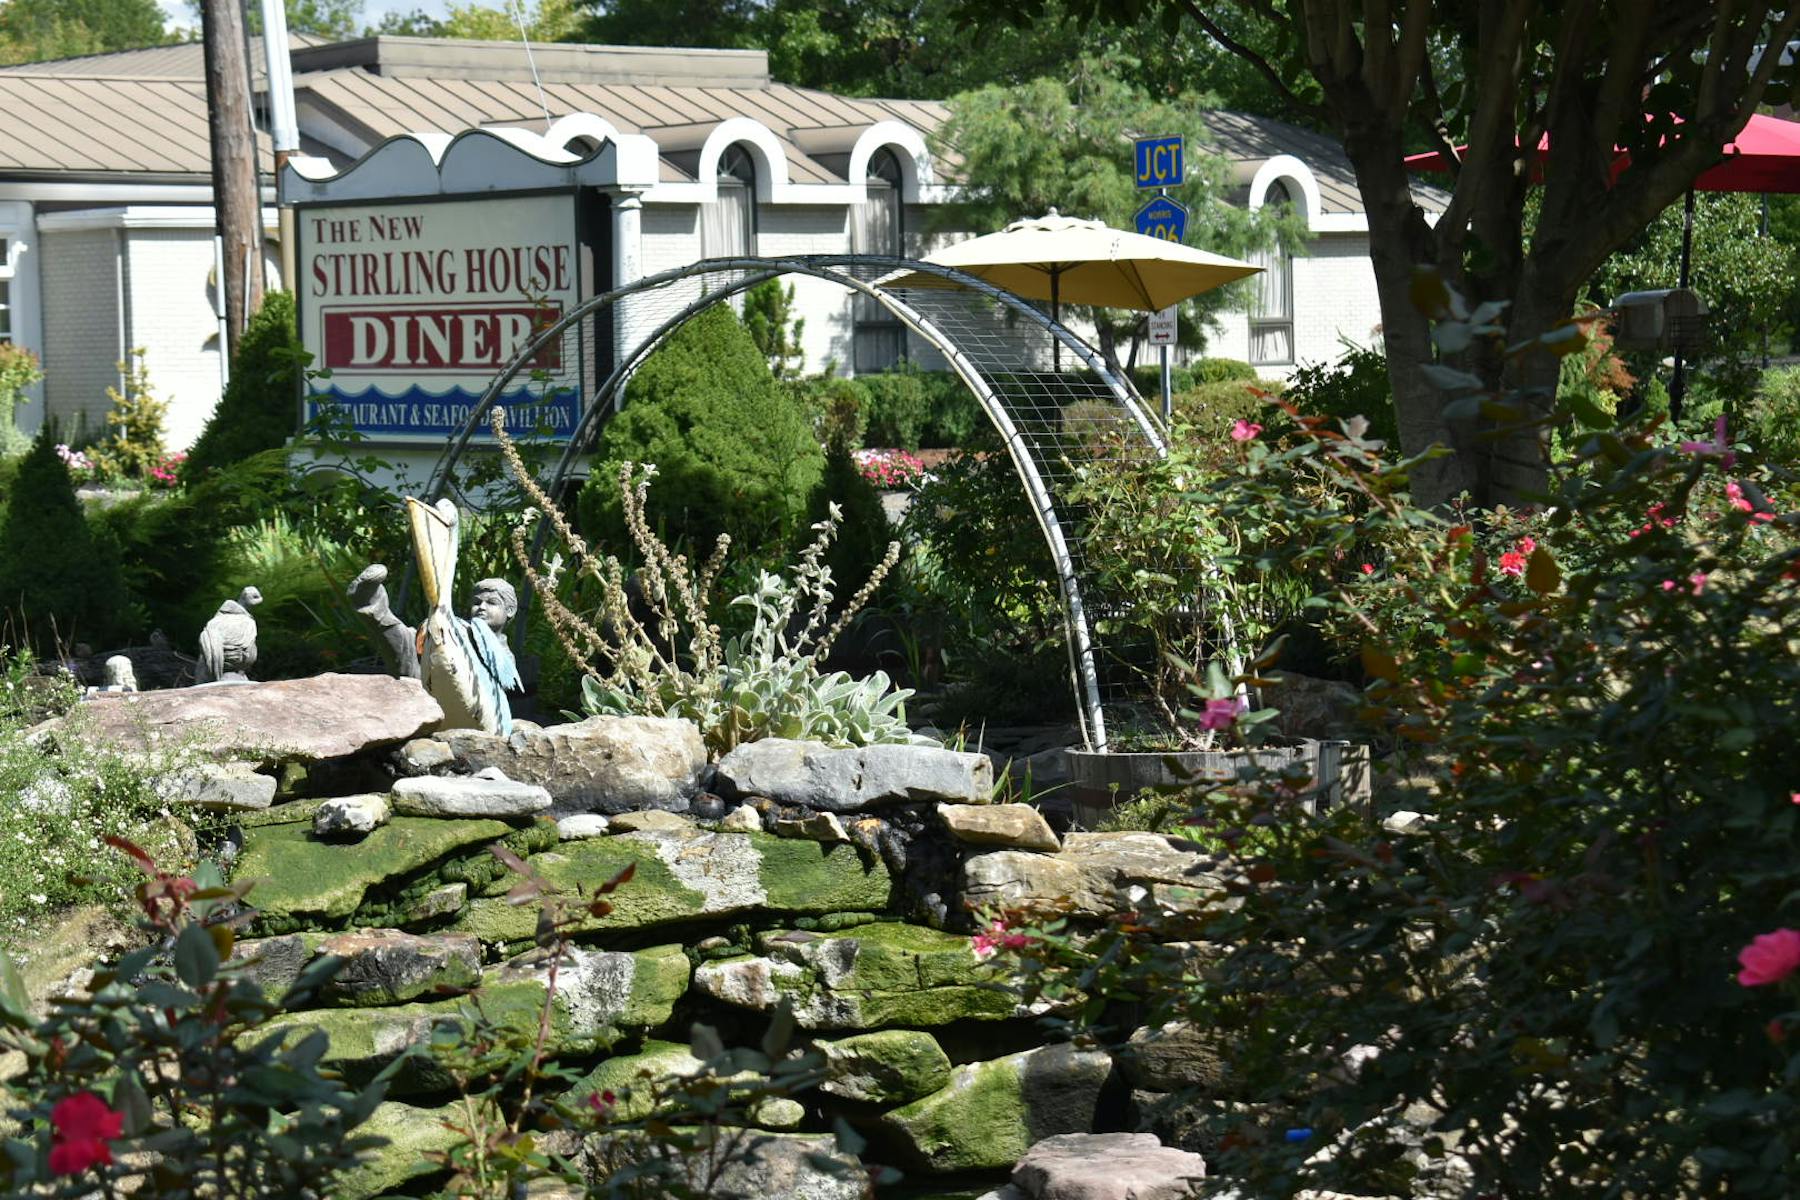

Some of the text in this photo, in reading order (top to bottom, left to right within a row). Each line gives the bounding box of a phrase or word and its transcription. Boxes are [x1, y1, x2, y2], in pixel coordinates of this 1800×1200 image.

[1138, 143, 1180, 181] JCT
[311, 214, 425, 244] THE NEW
[312, 244, 572, 298] STIRLING HOUSE
[349, 313, 537, 365] DINER
[410, 404, 421, 427] &
